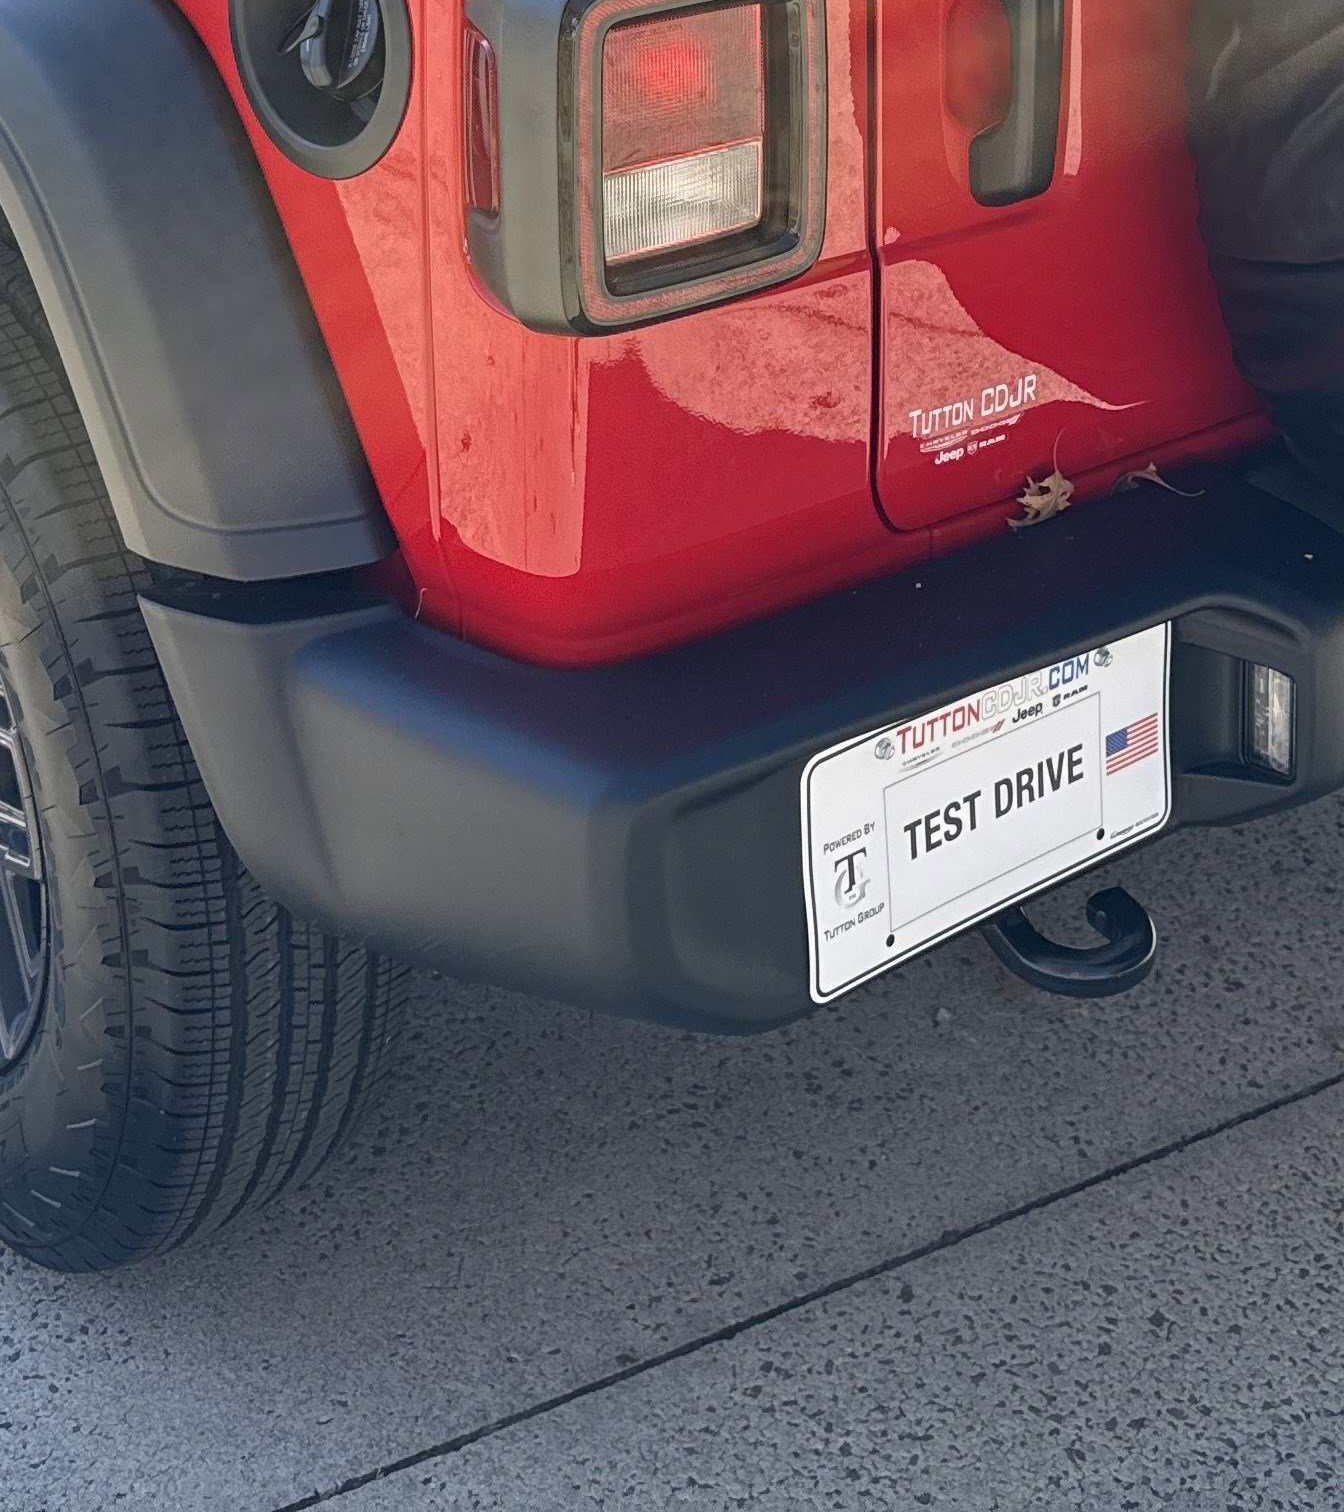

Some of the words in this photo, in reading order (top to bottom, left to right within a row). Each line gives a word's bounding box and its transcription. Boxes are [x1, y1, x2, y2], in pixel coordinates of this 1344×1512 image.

[909, 398, 975, 438] TUTTON
[980, 374, 1037, 418] CDJR
[934, 447, 965, 465] Jeep
[1012, 702, 1043, 724] Jeep
[1063, 685, 1089, 700] RAM
[903, 790, 982, 861] TEST
[994, 743, 1084, 819] DRIVE
[823, 829, 862, 855] POWERED
[863, 821, 876, 835] BY
[823, 918, 856, 942] TUTTON
[857, 901, 885, 924] GROUP
